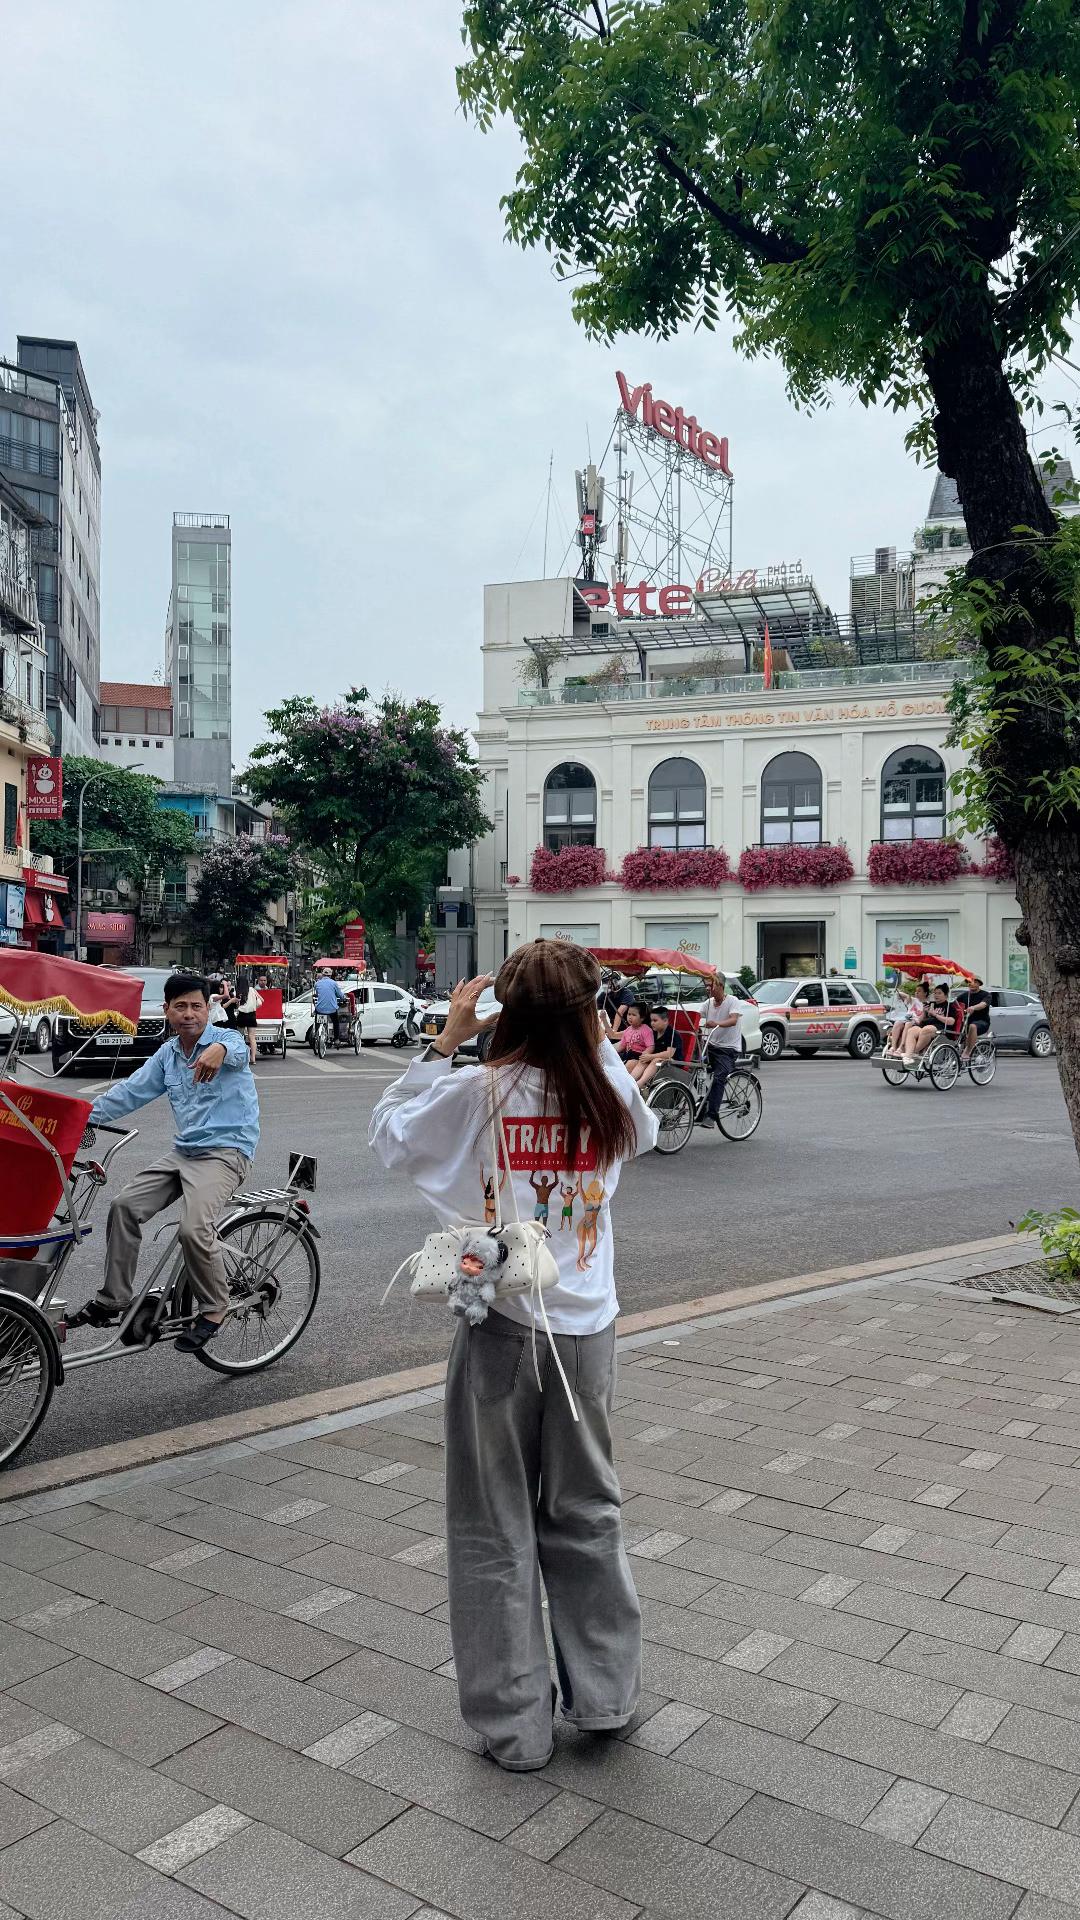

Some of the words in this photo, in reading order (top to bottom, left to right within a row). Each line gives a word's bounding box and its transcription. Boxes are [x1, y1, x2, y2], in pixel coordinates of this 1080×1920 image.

[615, 370, 733, 478] Viettel
[646, 718, 690, 731] TRUNG
[693, 715, 722, 729] TÂM
[725, 712, 775, 727] THÔNG
[778, 711, 801, 724] TIN
[804, 708, 834, 722] VĂN
[838, 704, 872, 719] HÓA
[28, 796, 58, 804] MIXUE
[911, 928, 936, 943] Sen
[677, 938, 700, 953] Sen
[805, 1022, 844, 1034] ANTV
[45, 1118, 58, 1135] 31
